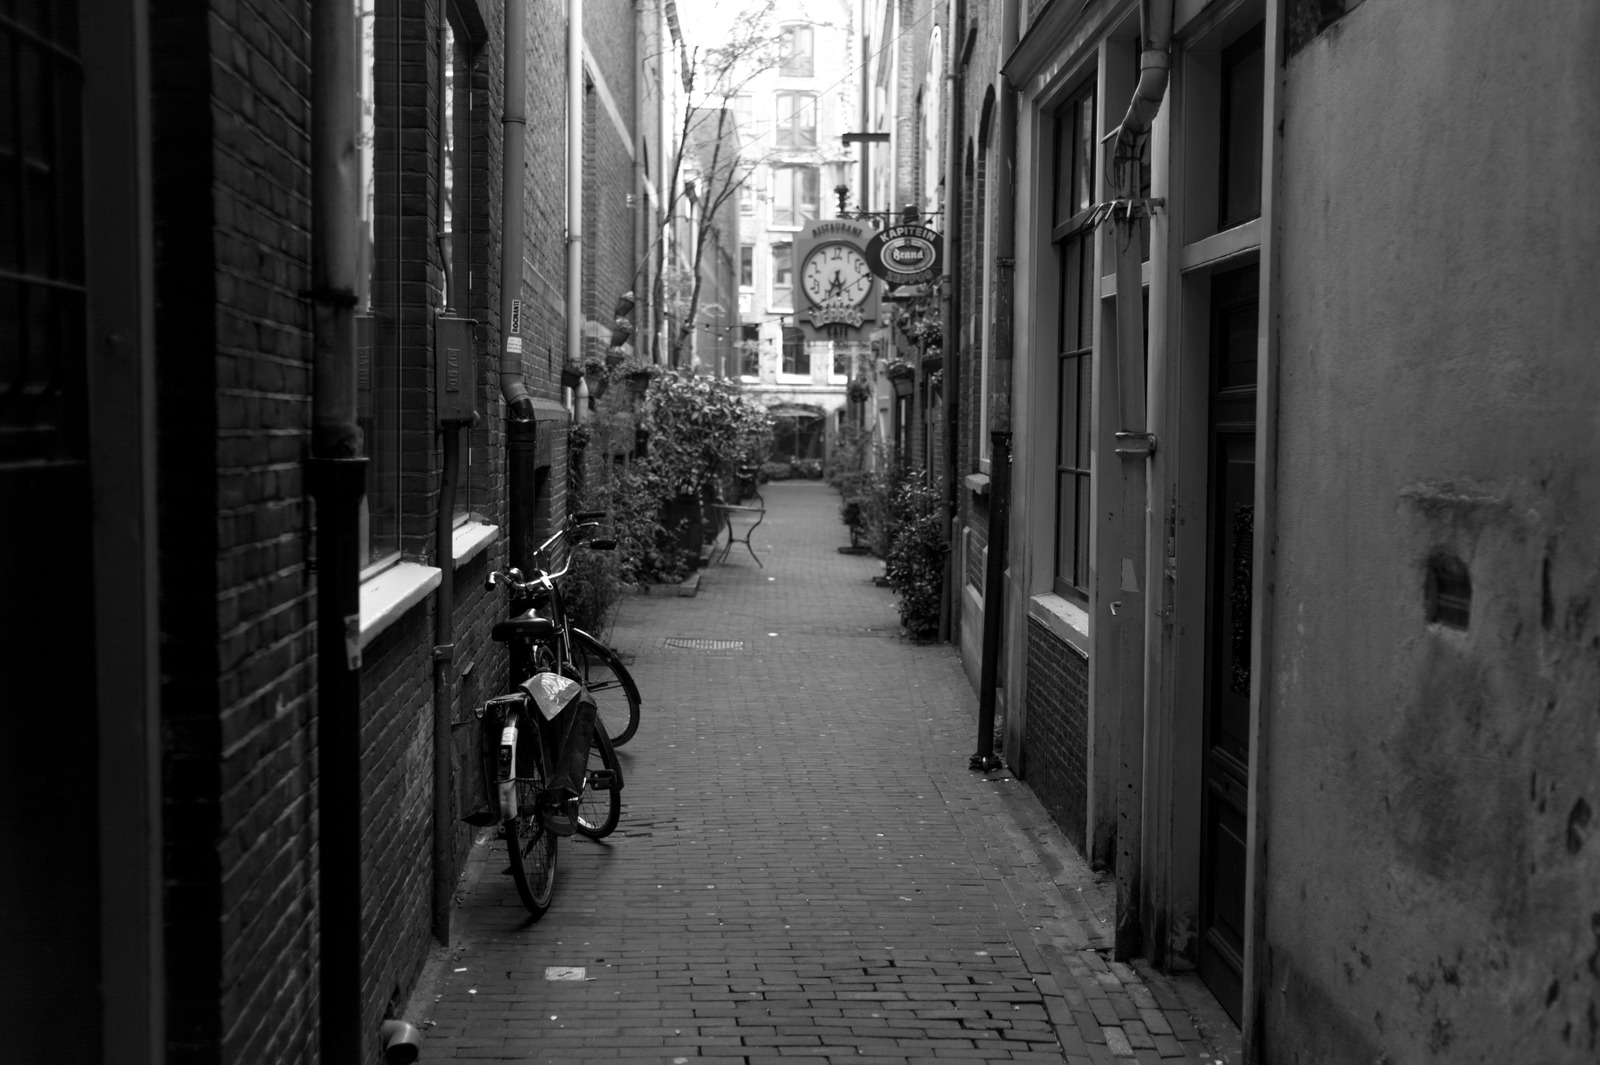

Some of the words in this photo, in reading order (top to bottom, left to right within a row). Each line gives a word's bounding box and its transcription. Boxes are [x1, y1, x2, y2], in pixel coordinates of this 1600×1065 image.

[879, 226, 937, 243] KAPITEIN
[893, 248, 924, 261] Brand
[885, 269, 934, 284] ZEPPOS
[813, 308, 863, 327] ZEPPOS
